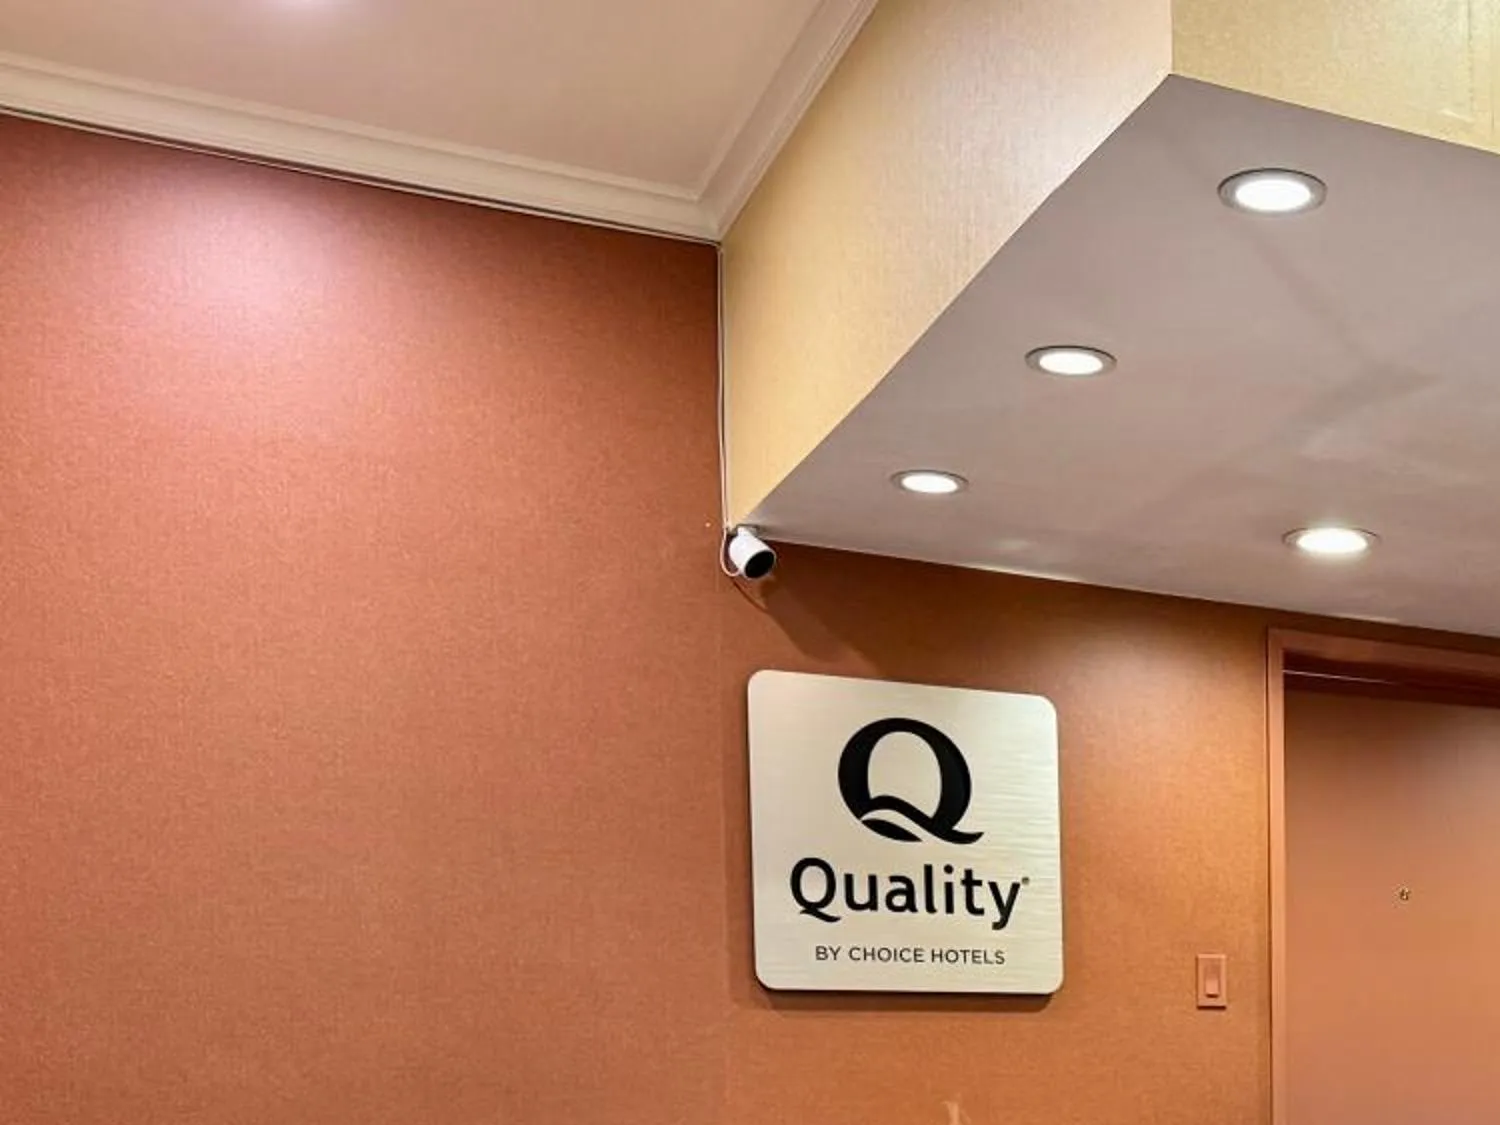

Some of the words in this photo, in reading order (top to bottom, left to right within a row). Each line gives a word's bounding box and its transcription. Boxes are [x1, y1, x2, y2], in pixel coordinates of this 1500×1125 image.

[838, 717, 985, 845] Q
[790, 857, 1021, 931] Quality
[815, 945, 842, 961] BY
[849, 946, 925, 963] CHOICE
[931, 949, 1006, 965] HOTELS
